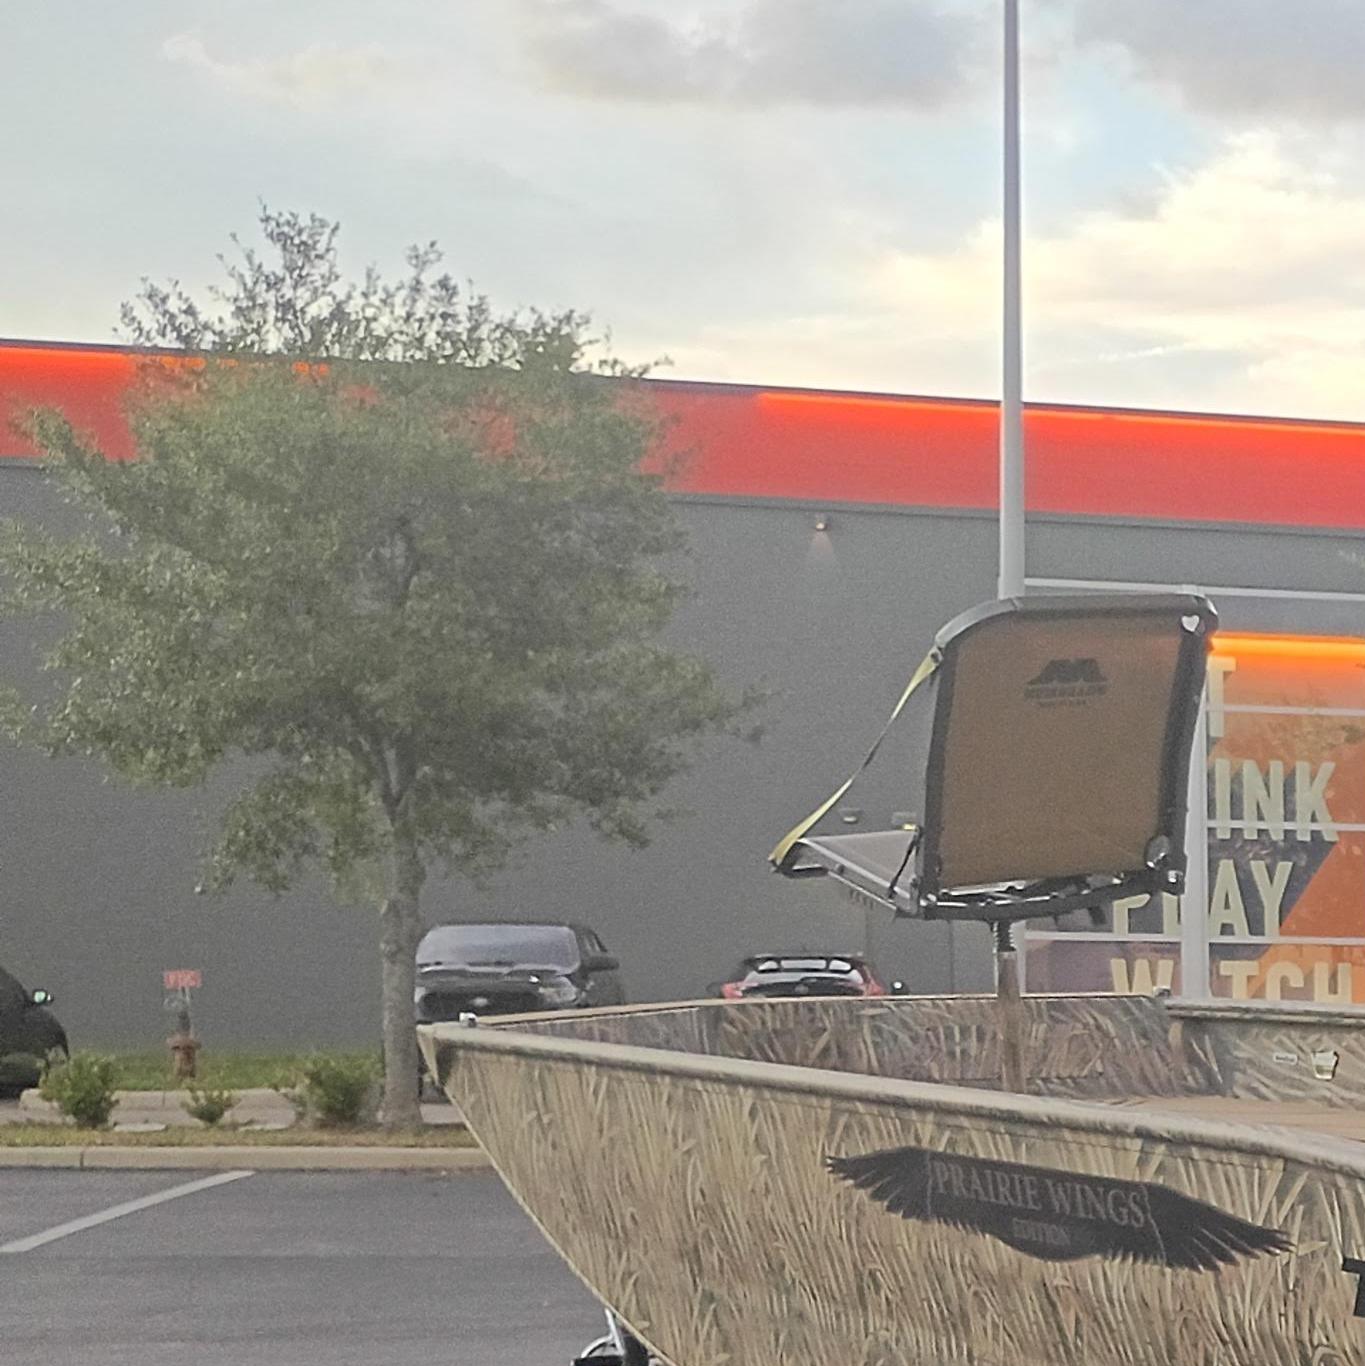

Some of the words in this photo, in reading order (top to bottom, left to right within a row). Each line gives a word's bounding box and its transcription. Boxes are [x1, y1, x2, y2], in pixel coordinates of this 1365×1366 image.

[1214, 758, 1338, 841] INK
[935, 1159, 1043, 1213] PRAIRIE
[1046, 1181, 1146, 1230] WINGS
